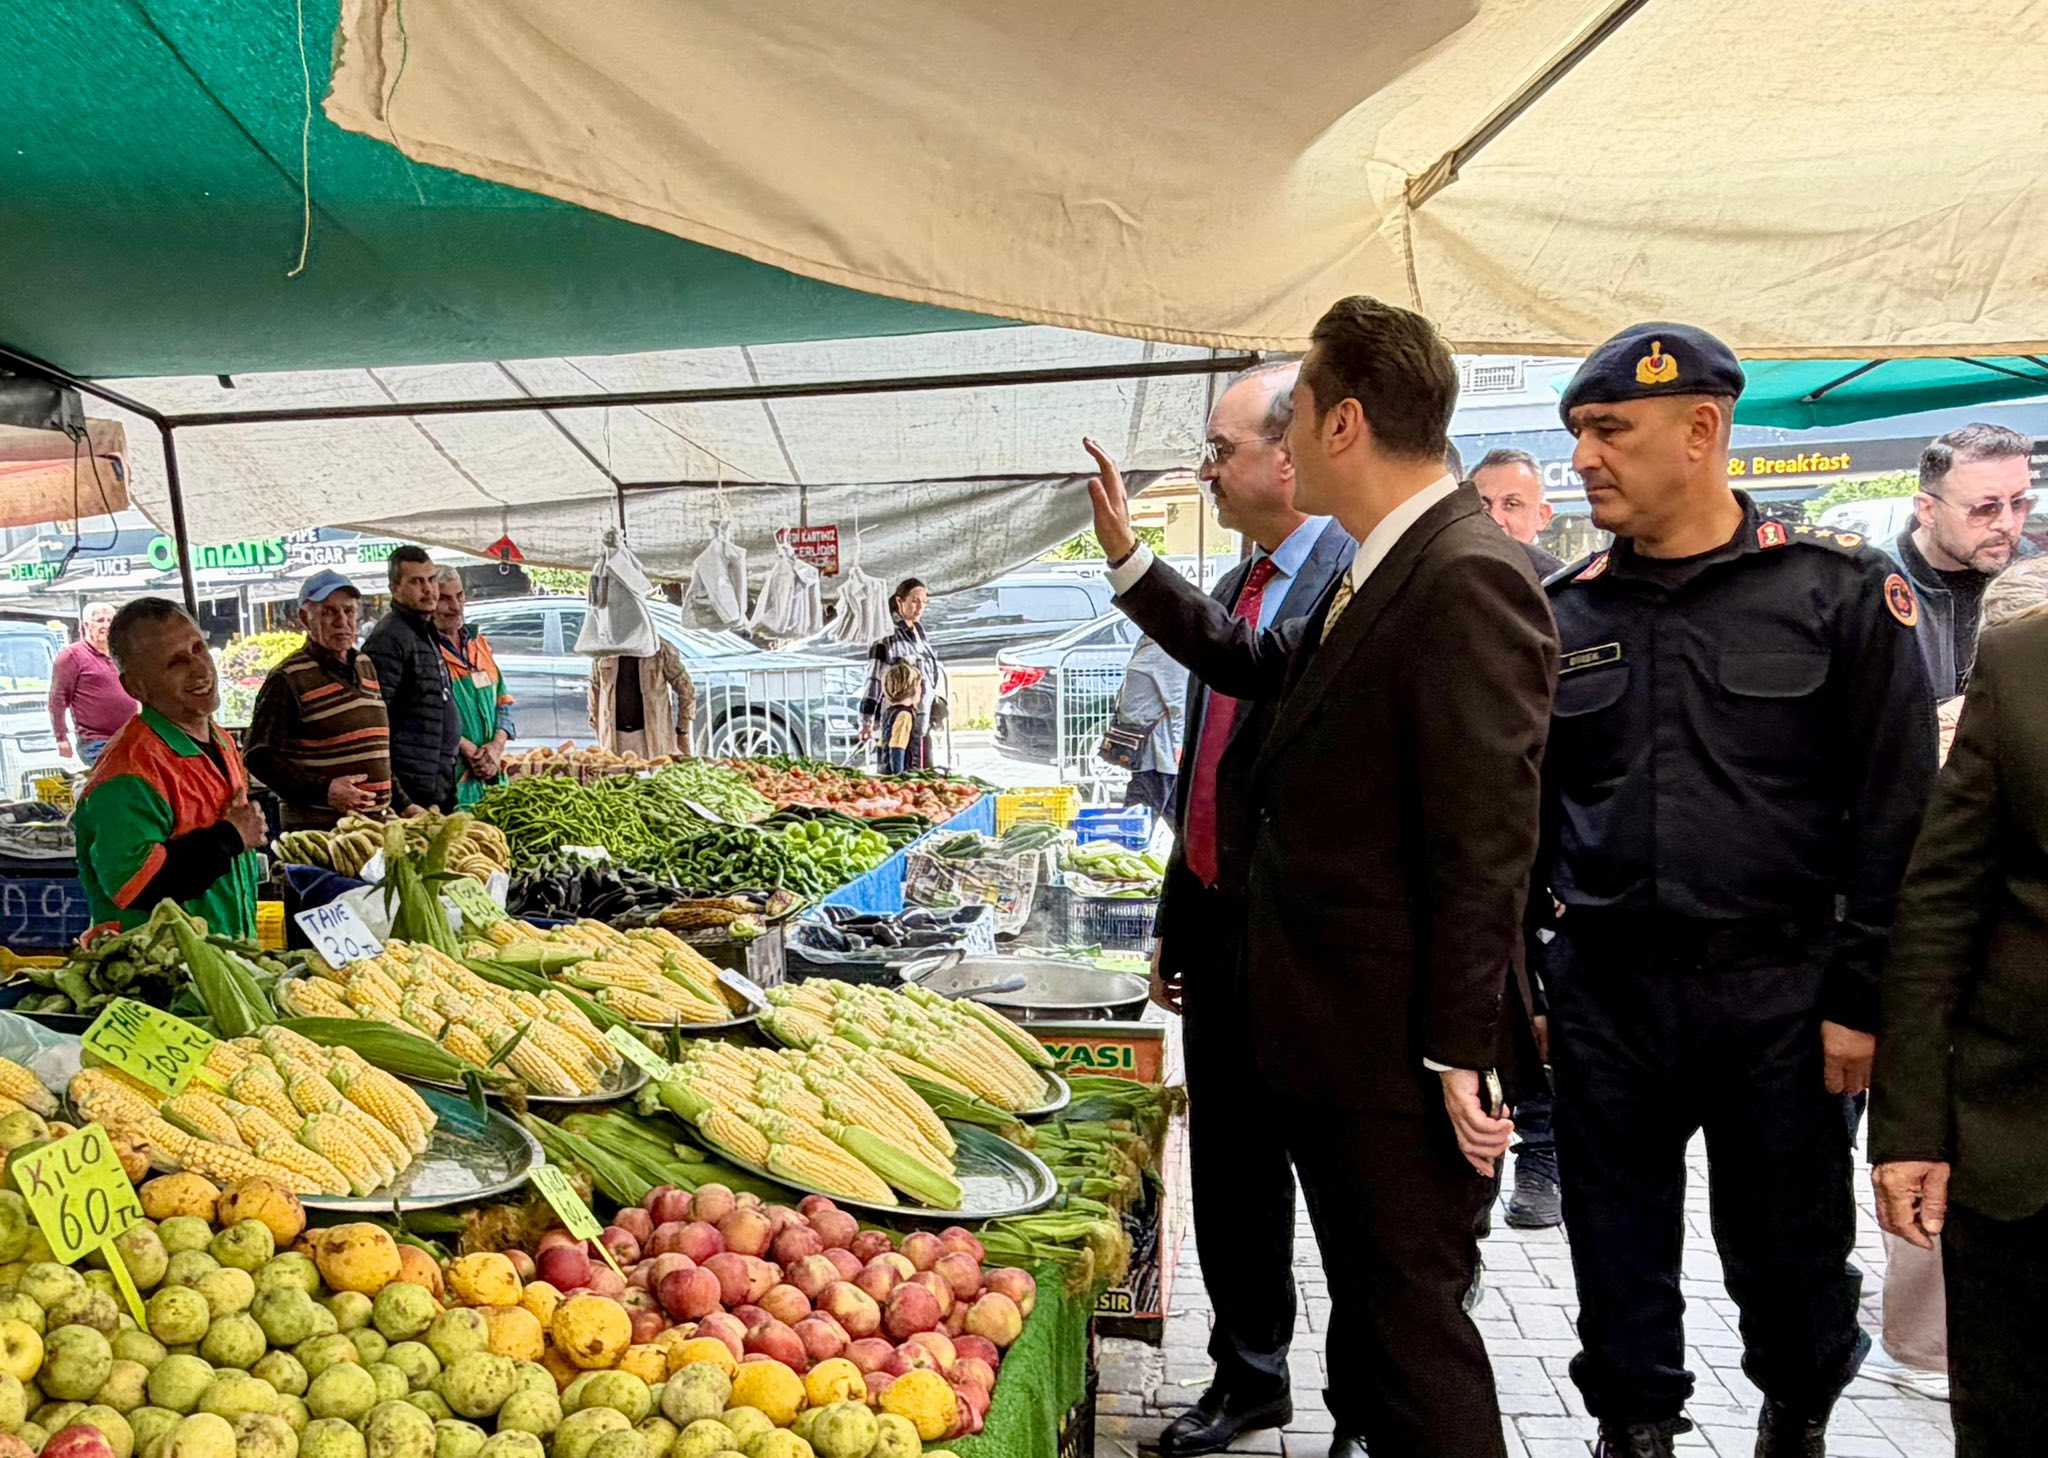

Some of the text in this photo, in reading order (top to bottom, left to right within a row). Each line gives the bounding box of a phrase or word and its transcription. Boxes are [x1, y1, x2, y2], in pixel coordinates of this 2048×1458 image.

[1543, 462, 1583, 487] CR
[1727, 452, 1850, 476] & Breakfast
[92, 558, 130, 577] JUICE
[301, 546, 345, 565] CIGAR
[60, 1188, 110, 1251] 60
